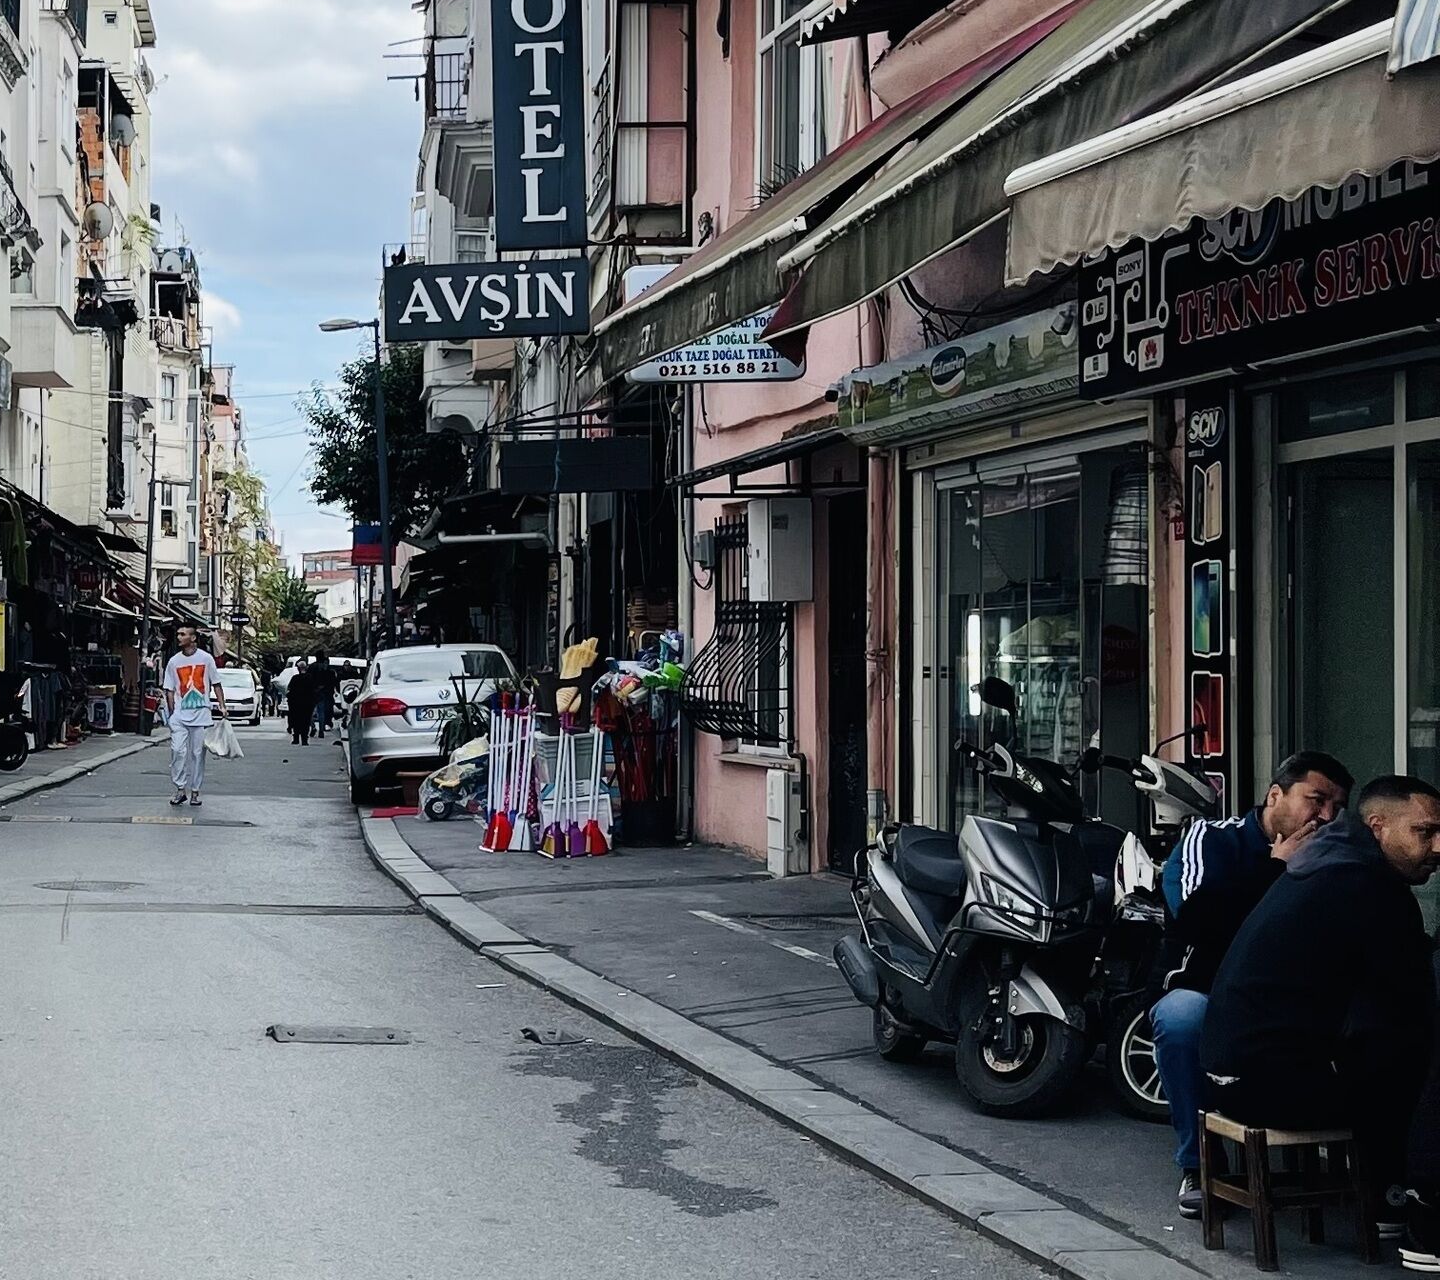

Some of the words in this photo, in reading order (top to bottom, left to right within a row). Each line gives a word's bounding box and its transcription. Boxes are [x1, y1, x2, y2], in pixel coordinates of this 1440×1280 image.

[1118, 259, 1142, 276] SONY
[398, 263, 576, 333] AVŞİN
[1095, 303, 1104, 317] LG
[717, 331, 750, 345] DOĞAL
[685, 351, 710, 362] TAZE
[712, 347, 745, 361] DOĞAL
[659, 364, 697, 377] 0212
[703, 363, 730, 375] 516
[736, 362, 756, 374] 88
[761, 361, 779, 373] 21
[422, 709, 435, 719] 20
